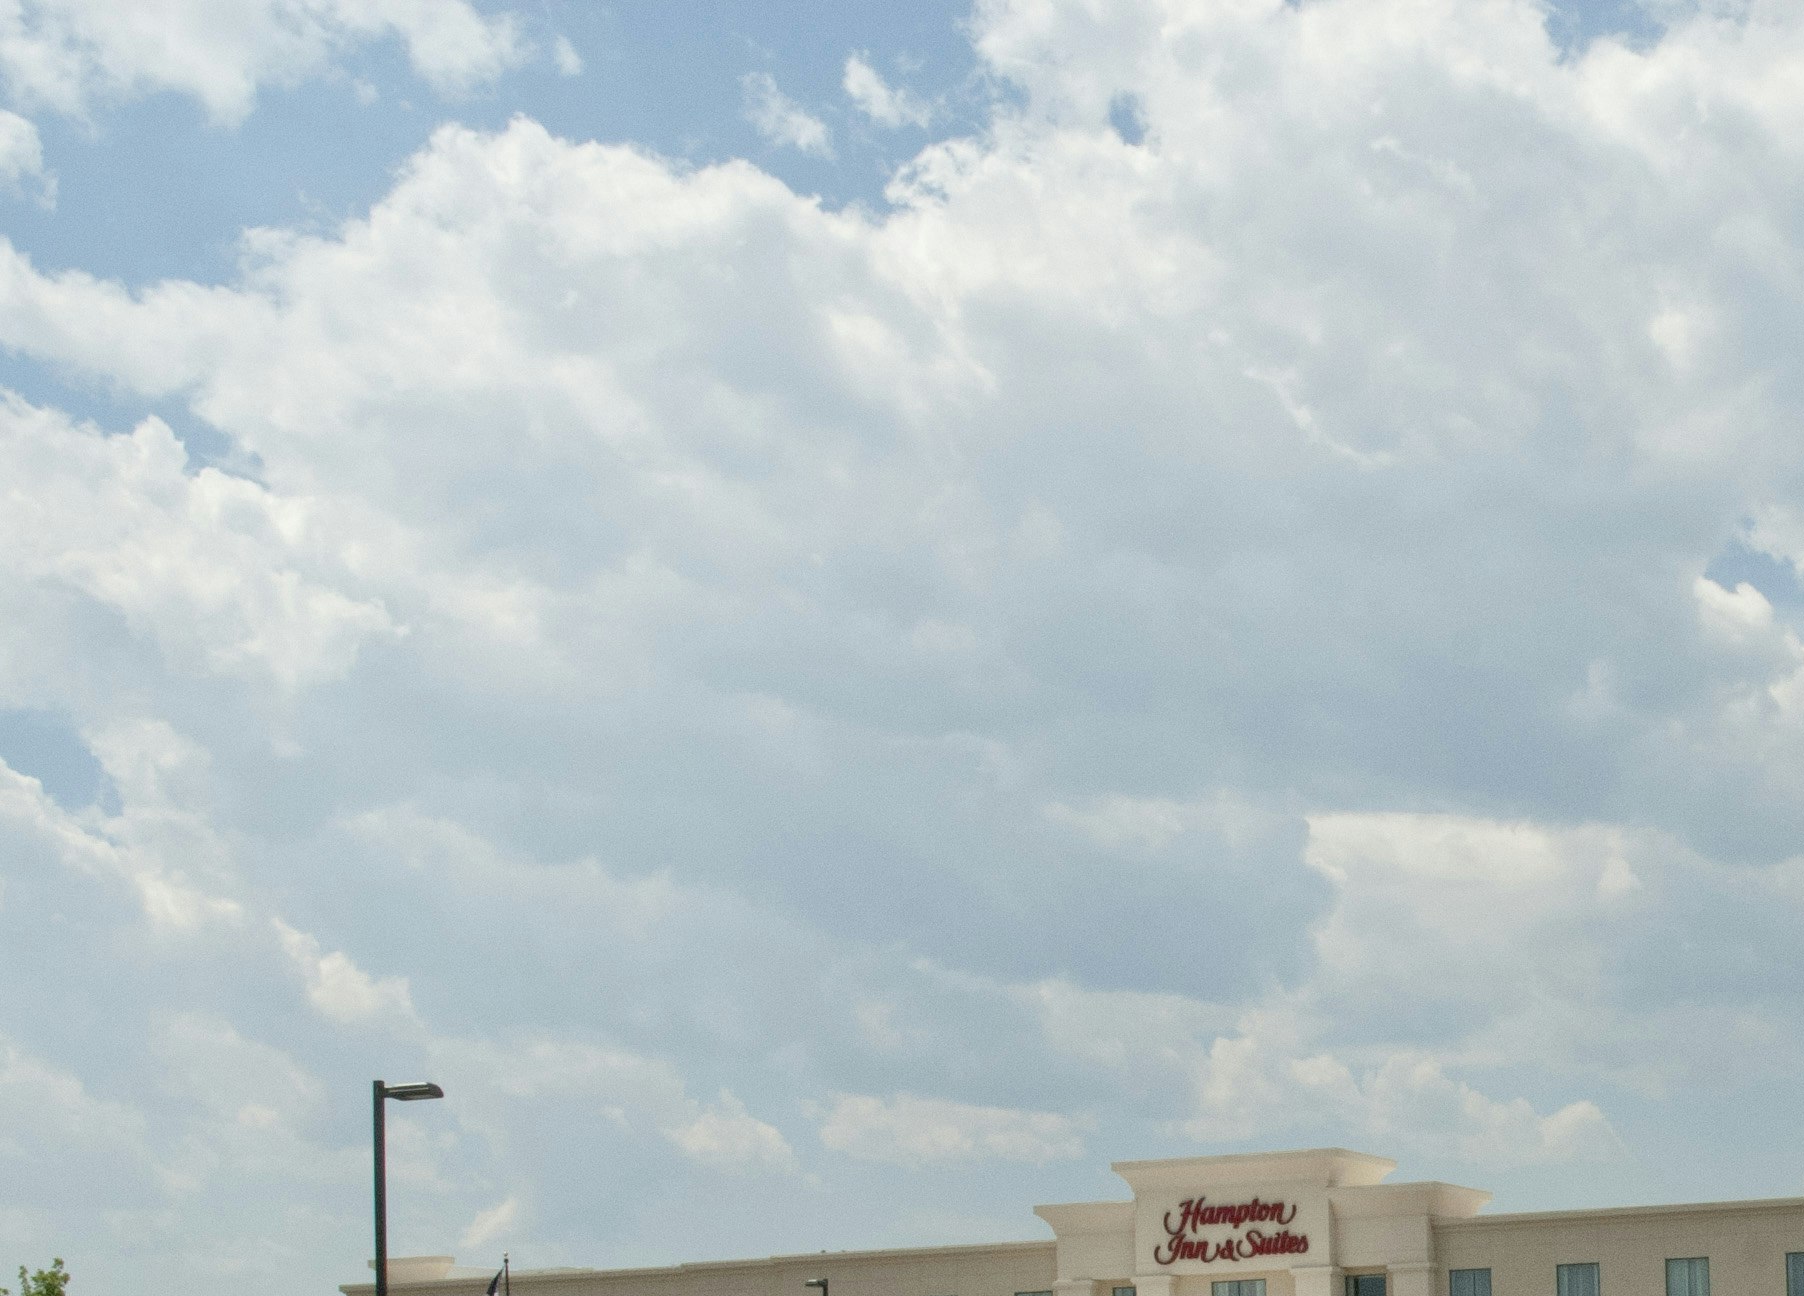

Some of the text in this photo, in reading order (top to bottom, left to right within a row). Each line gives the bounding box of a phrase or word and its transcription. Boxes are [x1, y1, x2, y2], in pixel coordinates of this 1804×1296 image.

[1163, 1197, 1297, 1236] Hampton
[1154, 1230, 1309, 1265] Inn & Suites
